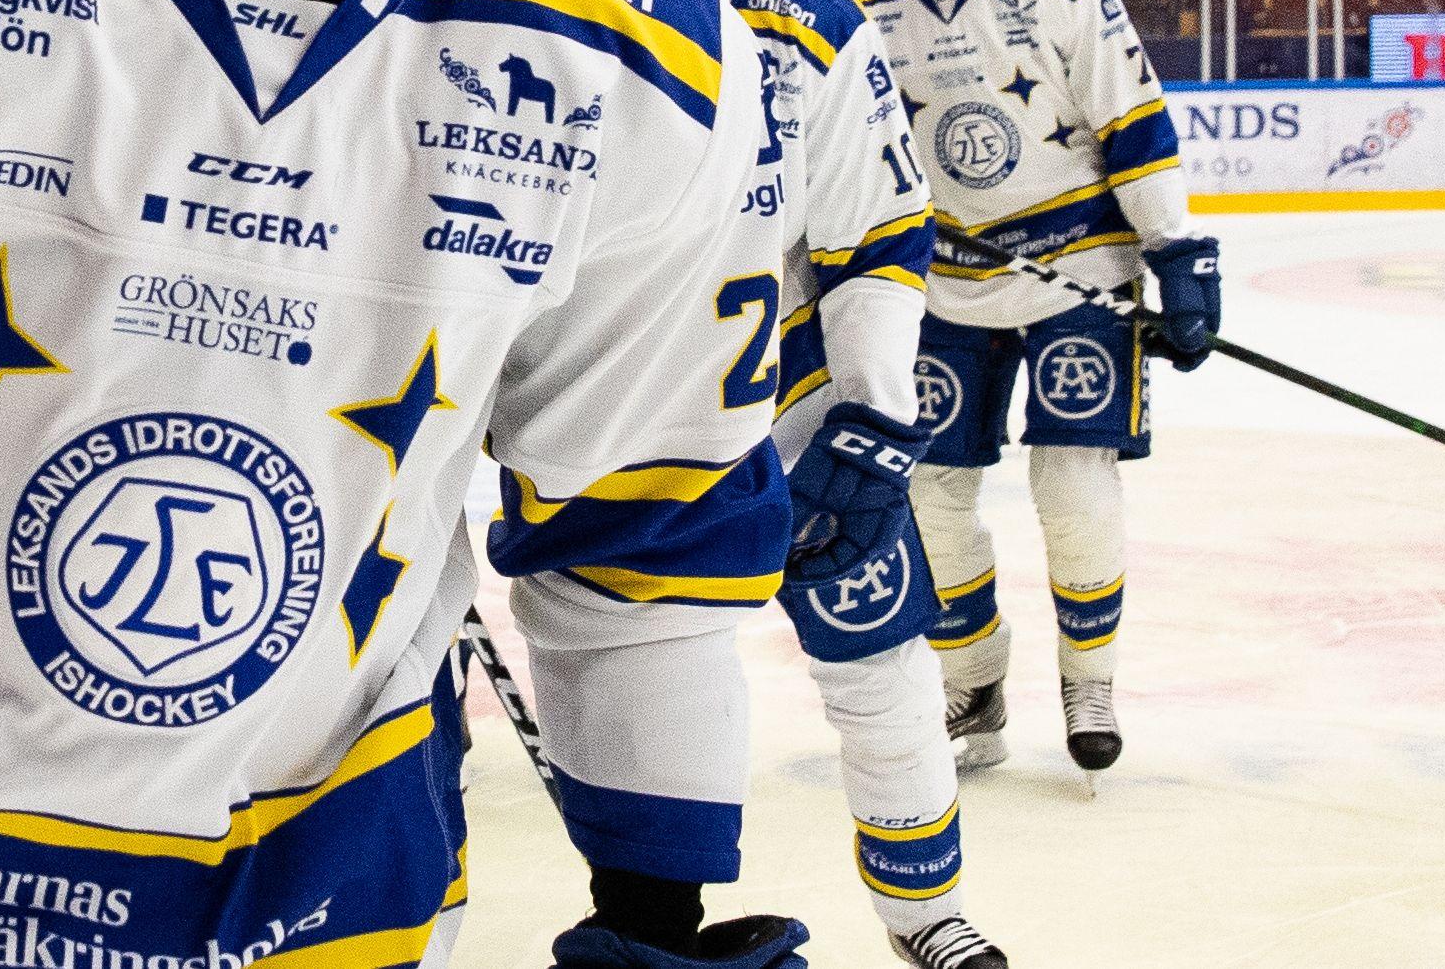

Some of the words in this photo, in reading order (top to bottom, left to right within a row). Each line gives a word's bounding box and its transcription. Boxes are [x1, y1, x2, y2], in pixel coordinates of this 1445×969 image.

[233, 3, 306, 40] SHL
[187, 151, 314, 189] CCM
[120, 273, 319, 331] GRÖNSAKS
[165, 313, 291, 363] HUSET
[11, 434, 118, 619] LEKSANDS
[44, 649, 240, 727] ISHOCKEY
